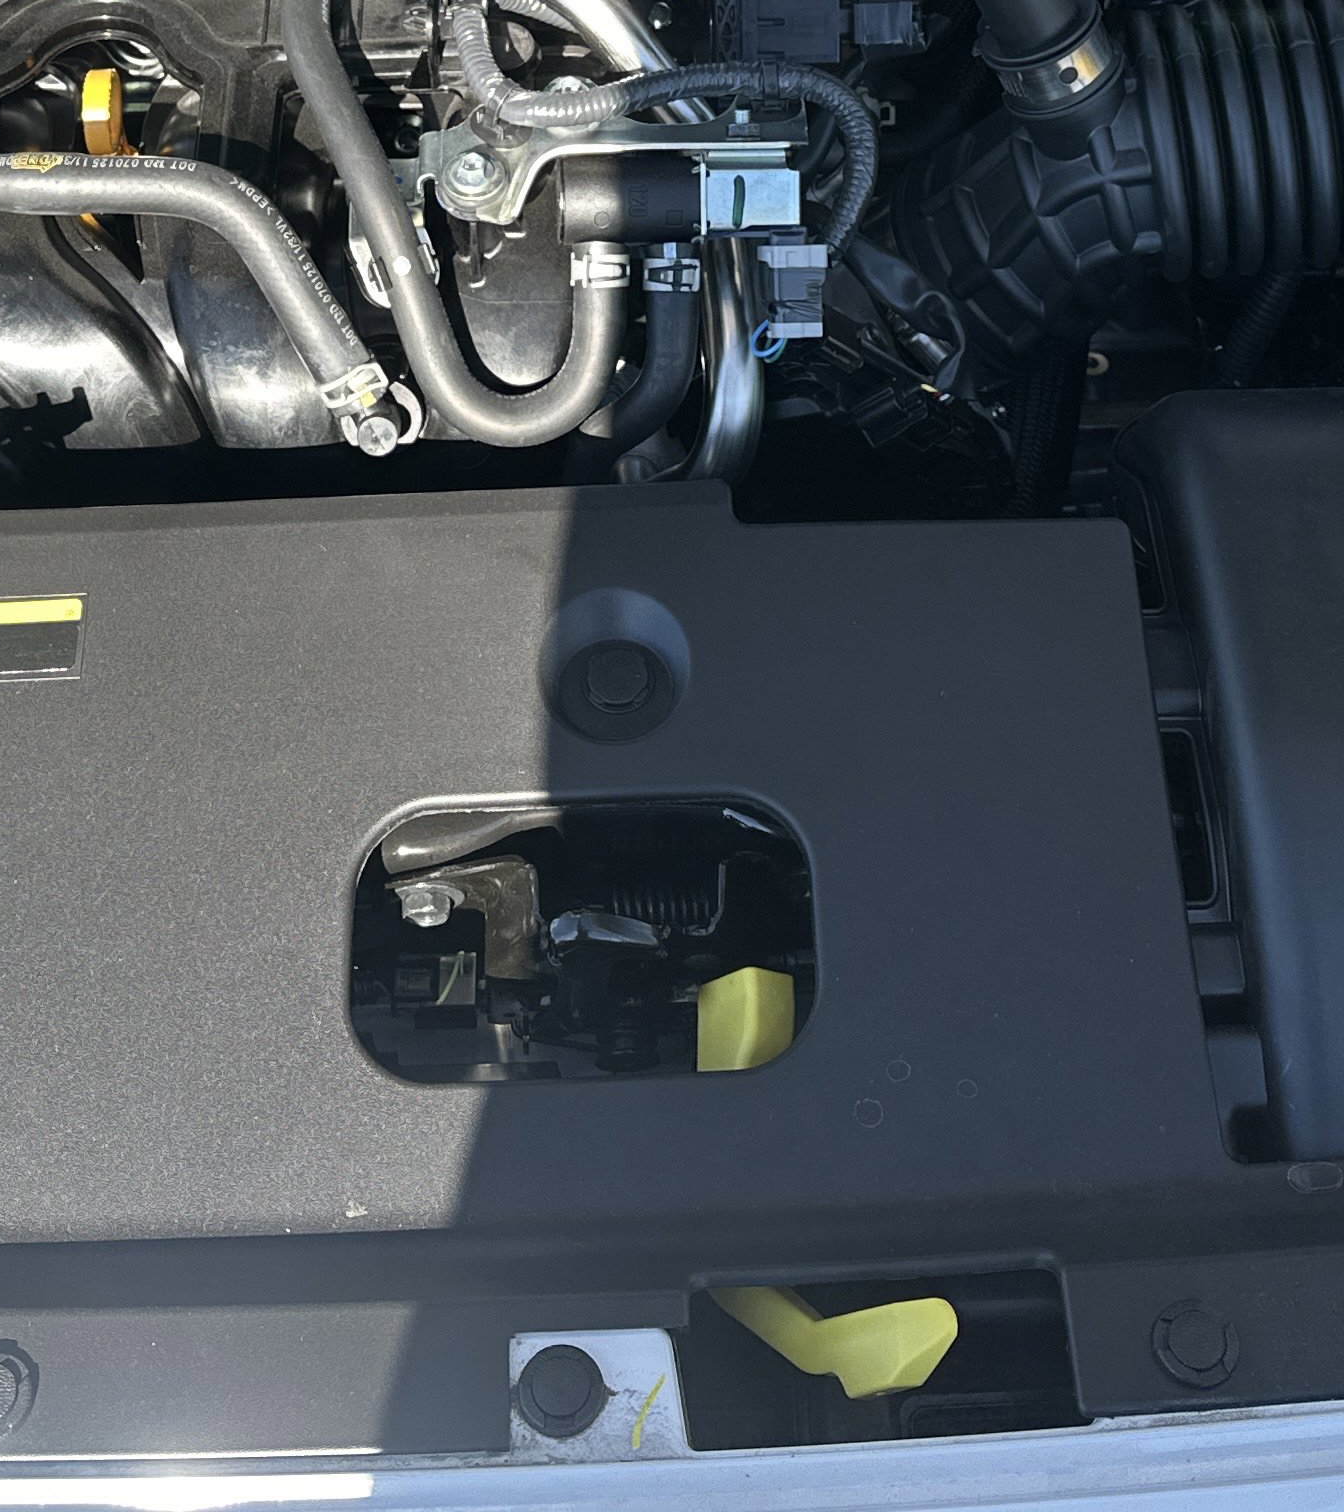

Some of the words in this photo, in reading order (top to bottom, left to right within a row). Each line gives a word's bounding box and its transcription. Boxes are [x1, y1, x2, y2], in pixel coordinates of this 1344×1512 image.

[91, 158, 139, 168] 070125
[170, 160, 197, 172] DOT
[228, 176, 276, 217] >EPDM<
[302, 261, 332, 304] 070125
[341, 325, 358, 346] DOT
